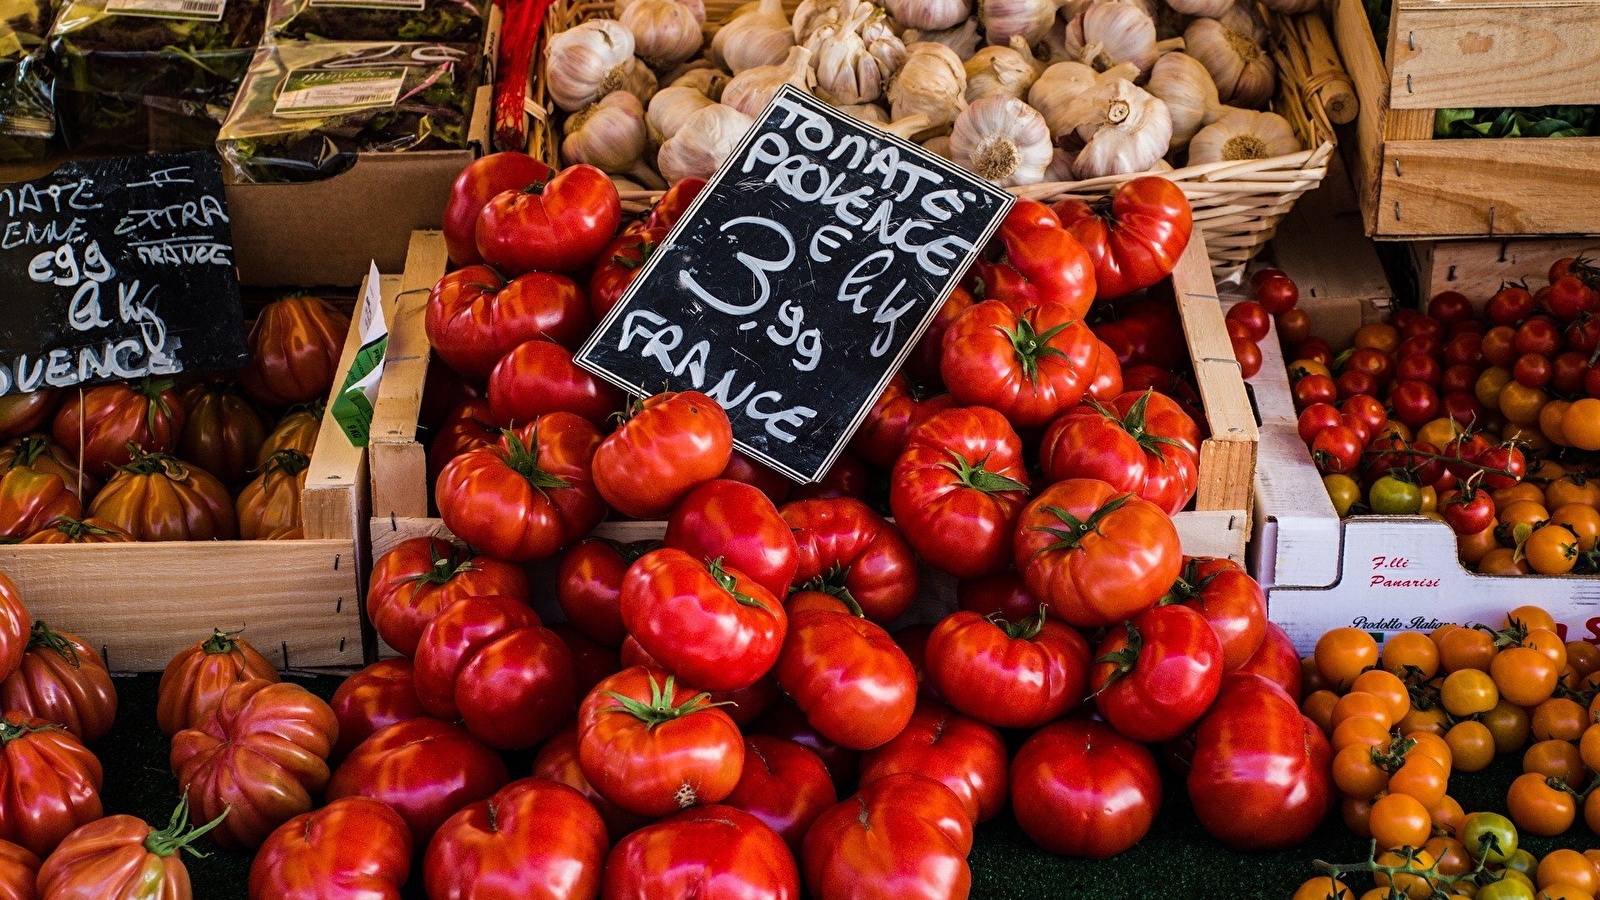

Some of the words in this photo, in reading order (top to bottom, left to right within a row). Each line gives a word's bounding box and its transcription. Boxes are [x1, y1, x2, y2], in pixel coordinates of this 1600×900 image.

[114, 195, 229, 235] EXTRA
[742, 132, 975, 276] PROVENCE
[137, 242, 232, 266] FRANCE
[617, 309, 818, 444] FRANCE
[1369, 575, 1441, 588] Panarisi
[1349, 616, 1403, 629] Prodotto
